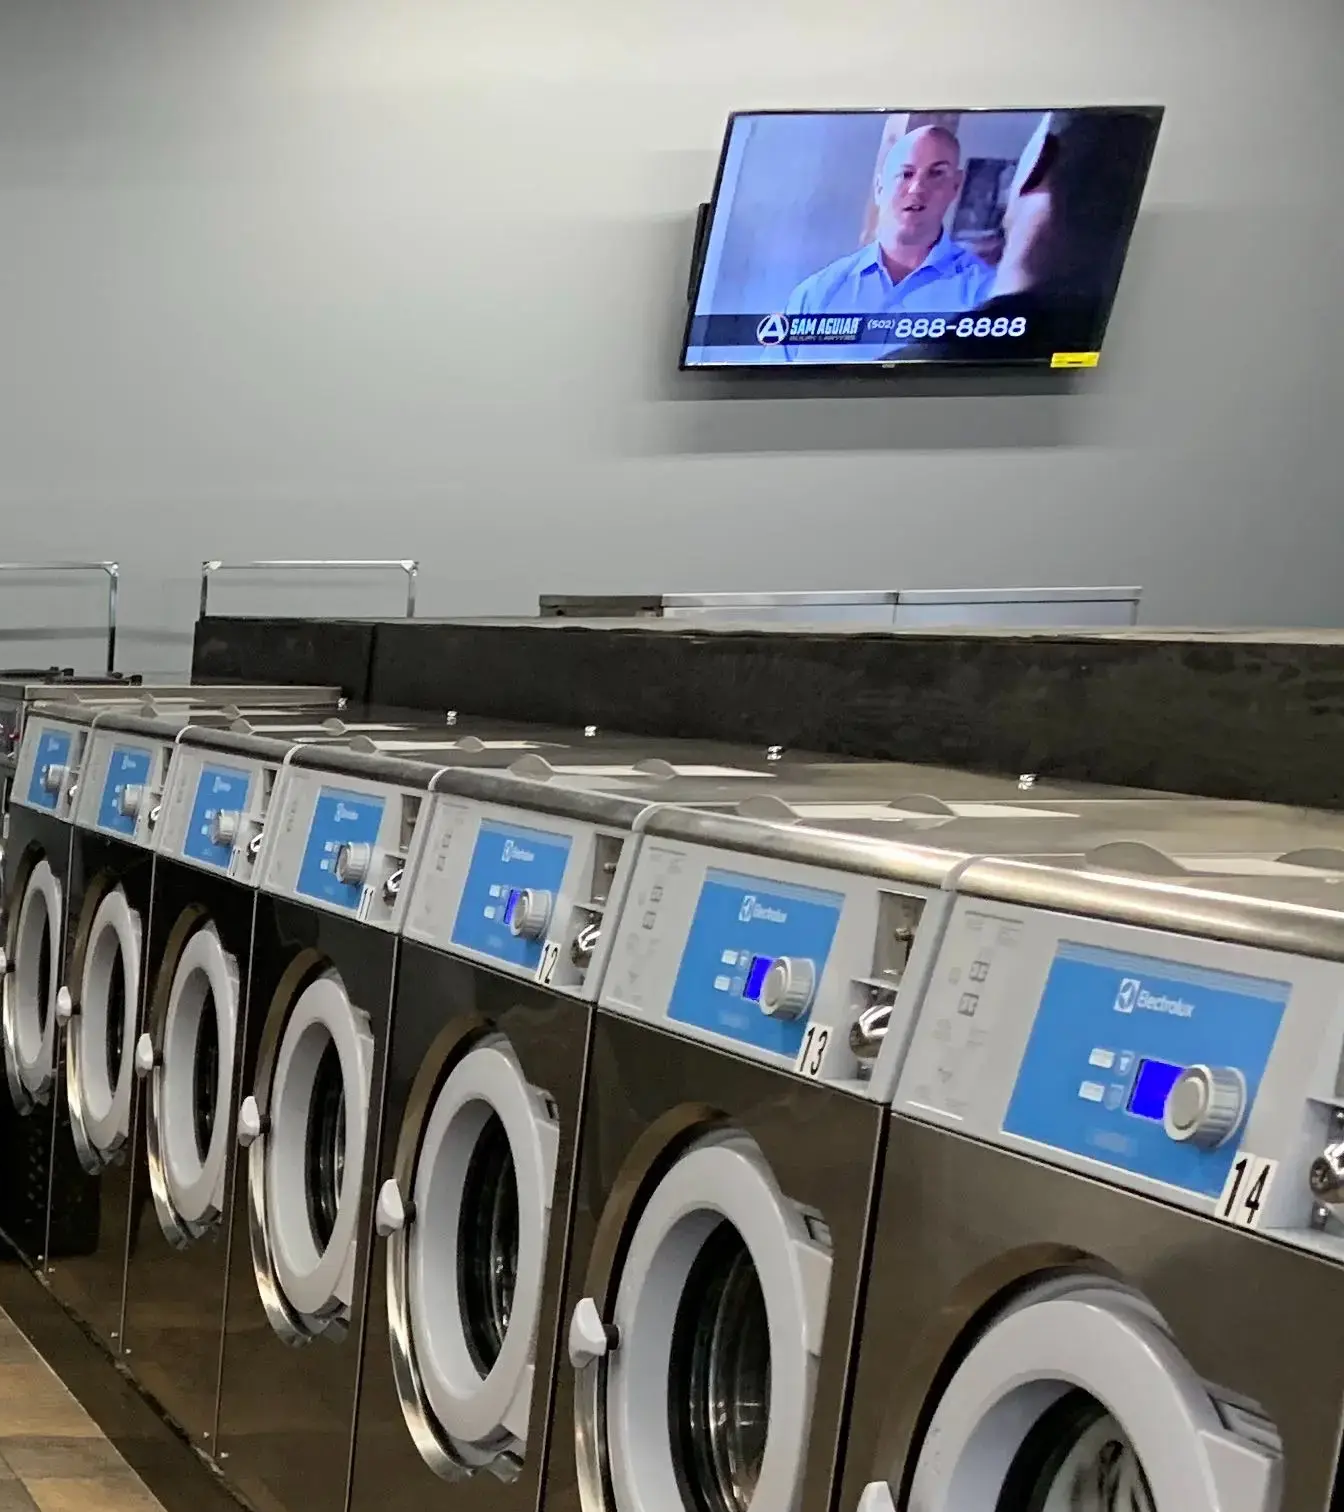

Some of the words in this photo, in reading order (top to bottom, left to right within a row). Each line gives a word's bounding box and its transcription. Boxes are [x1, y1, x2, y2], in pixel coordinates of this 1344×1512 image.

[790, 318, 818, 335] SAM
[867, 319, 896, 331] (502)
[895, 316, 1027, 338] 888-8888
[537, 943, 561, 984] 12
[1136, 990, 1196, 1018] Electrolux
[800, 1026, 829, 1075] 13
[1224, 1158, 1272, 1224] 14
